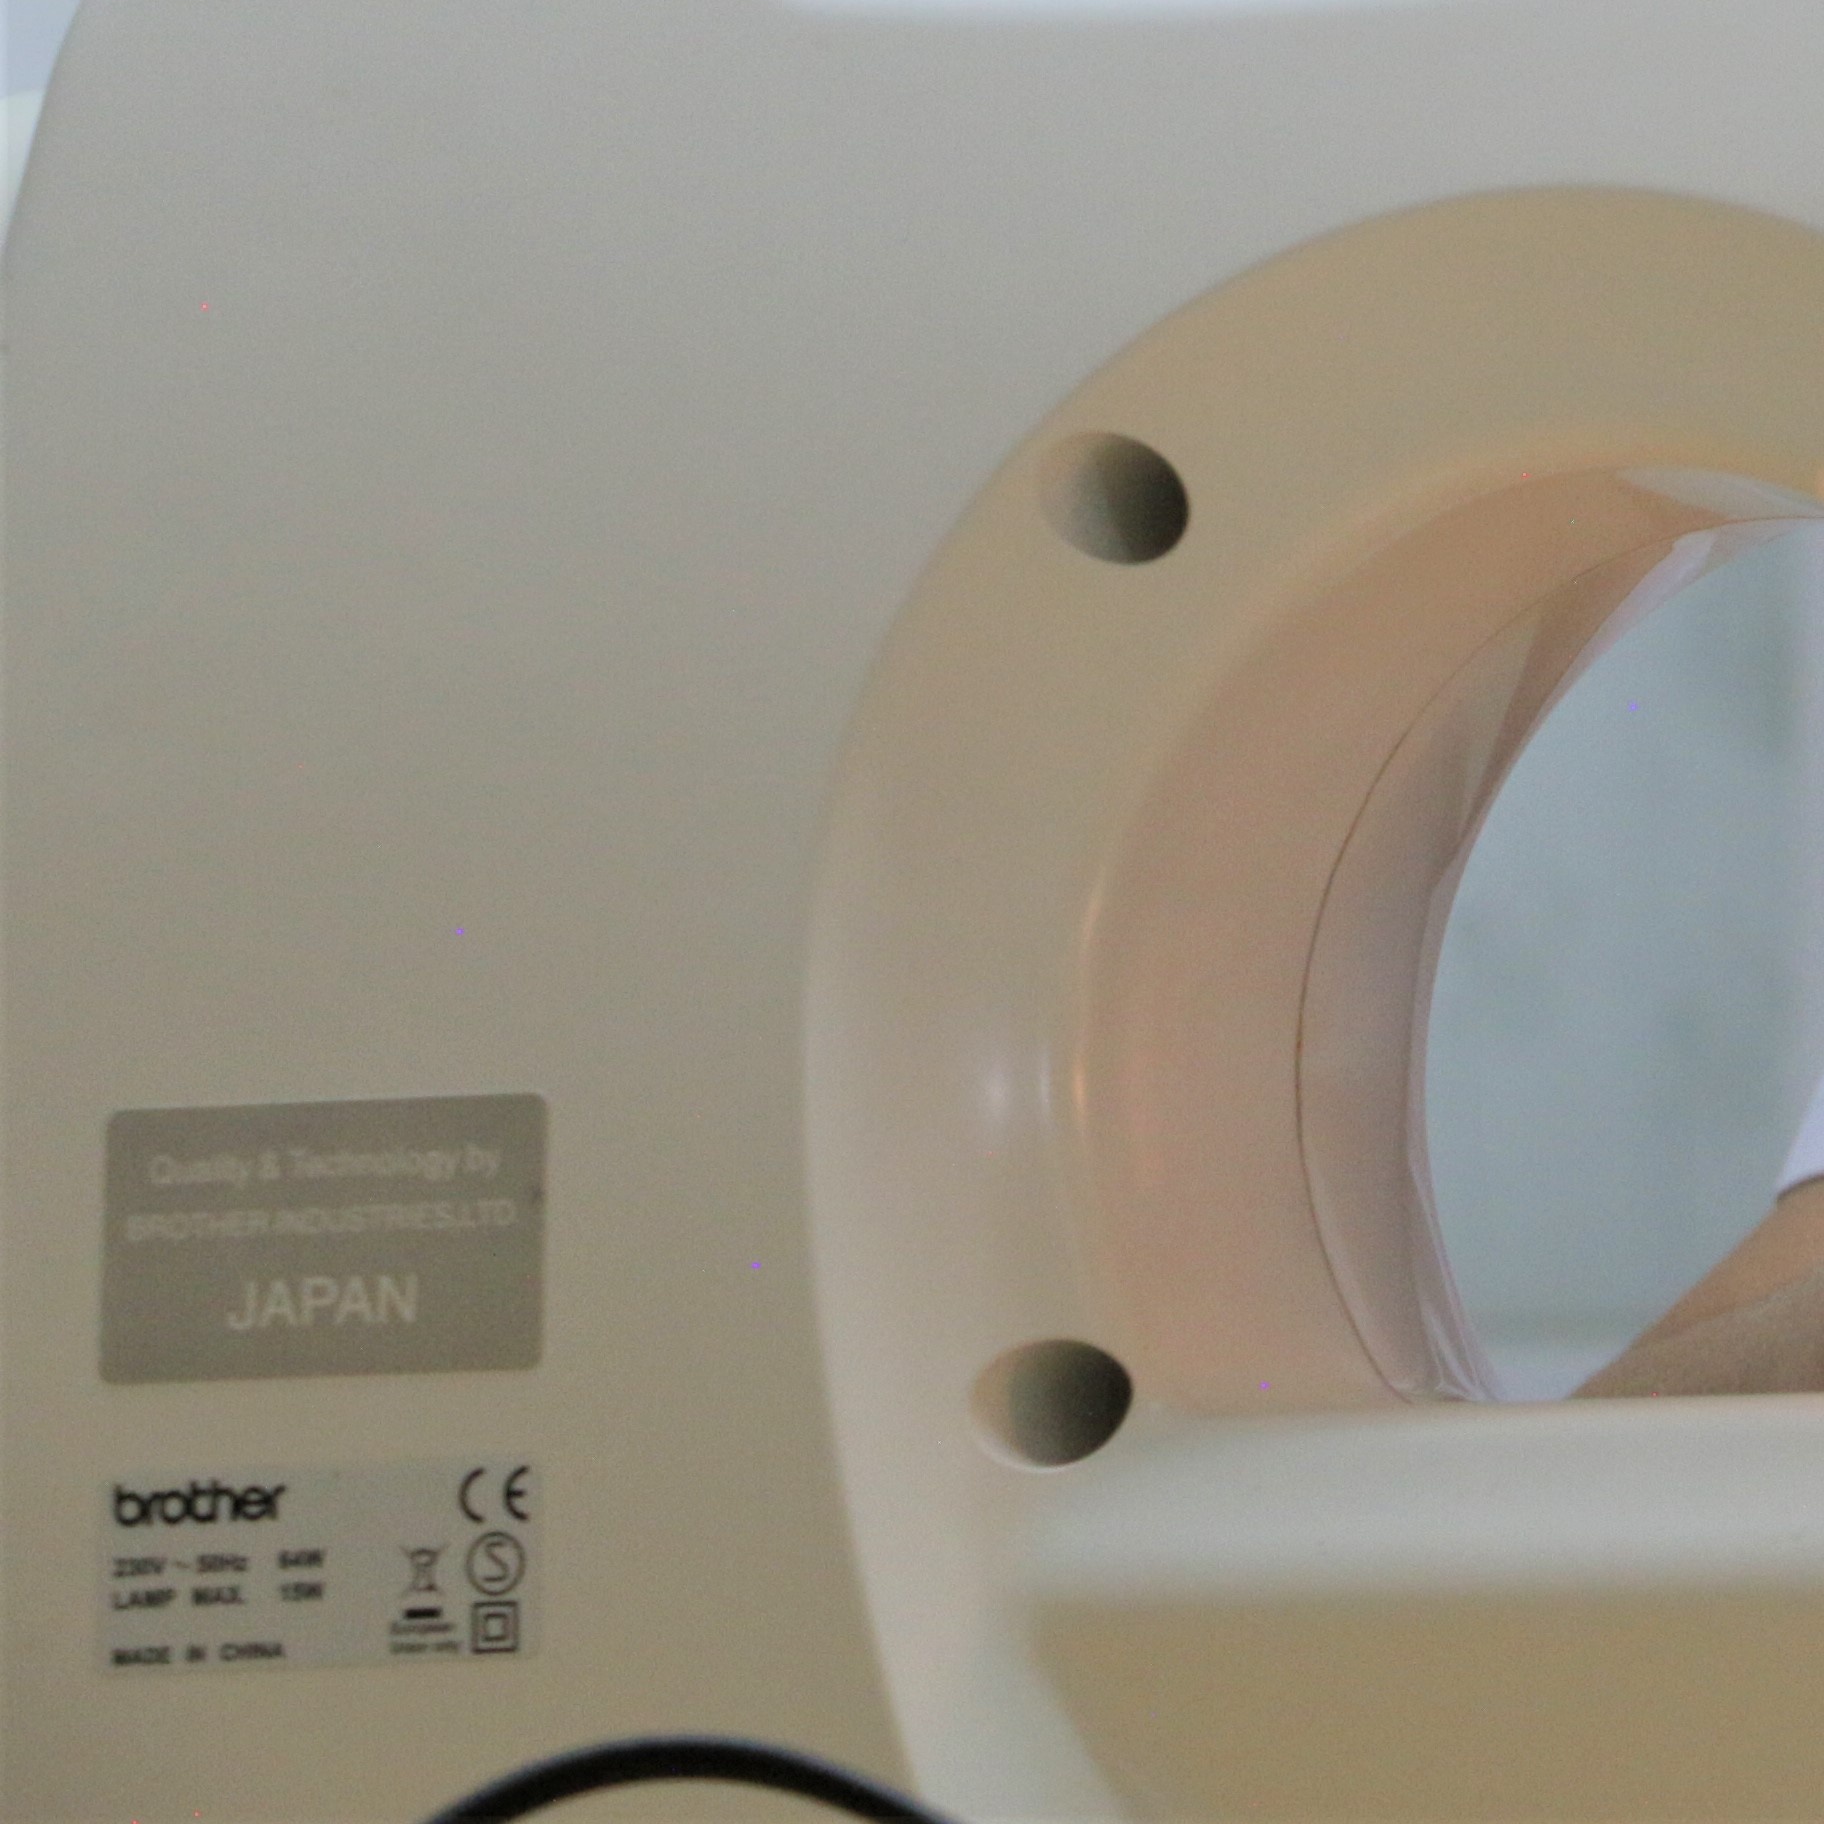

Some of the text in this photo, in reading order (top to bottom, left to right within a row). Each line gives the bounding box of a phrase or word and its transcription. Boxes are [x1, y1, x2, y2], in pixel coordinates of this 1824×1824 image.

[464, 1142, 503, 1180] by
[125, 1208, 269, 1242] BROTHER
[227, 1272, 419, 1333] JAPAN
[112, 1479, 288, 1527] brother
[112, 1587, 176, 1611] LAMP
[111, 1644, 170, 1667] MADE
[219, 1640, 287, 1663] CHINA
